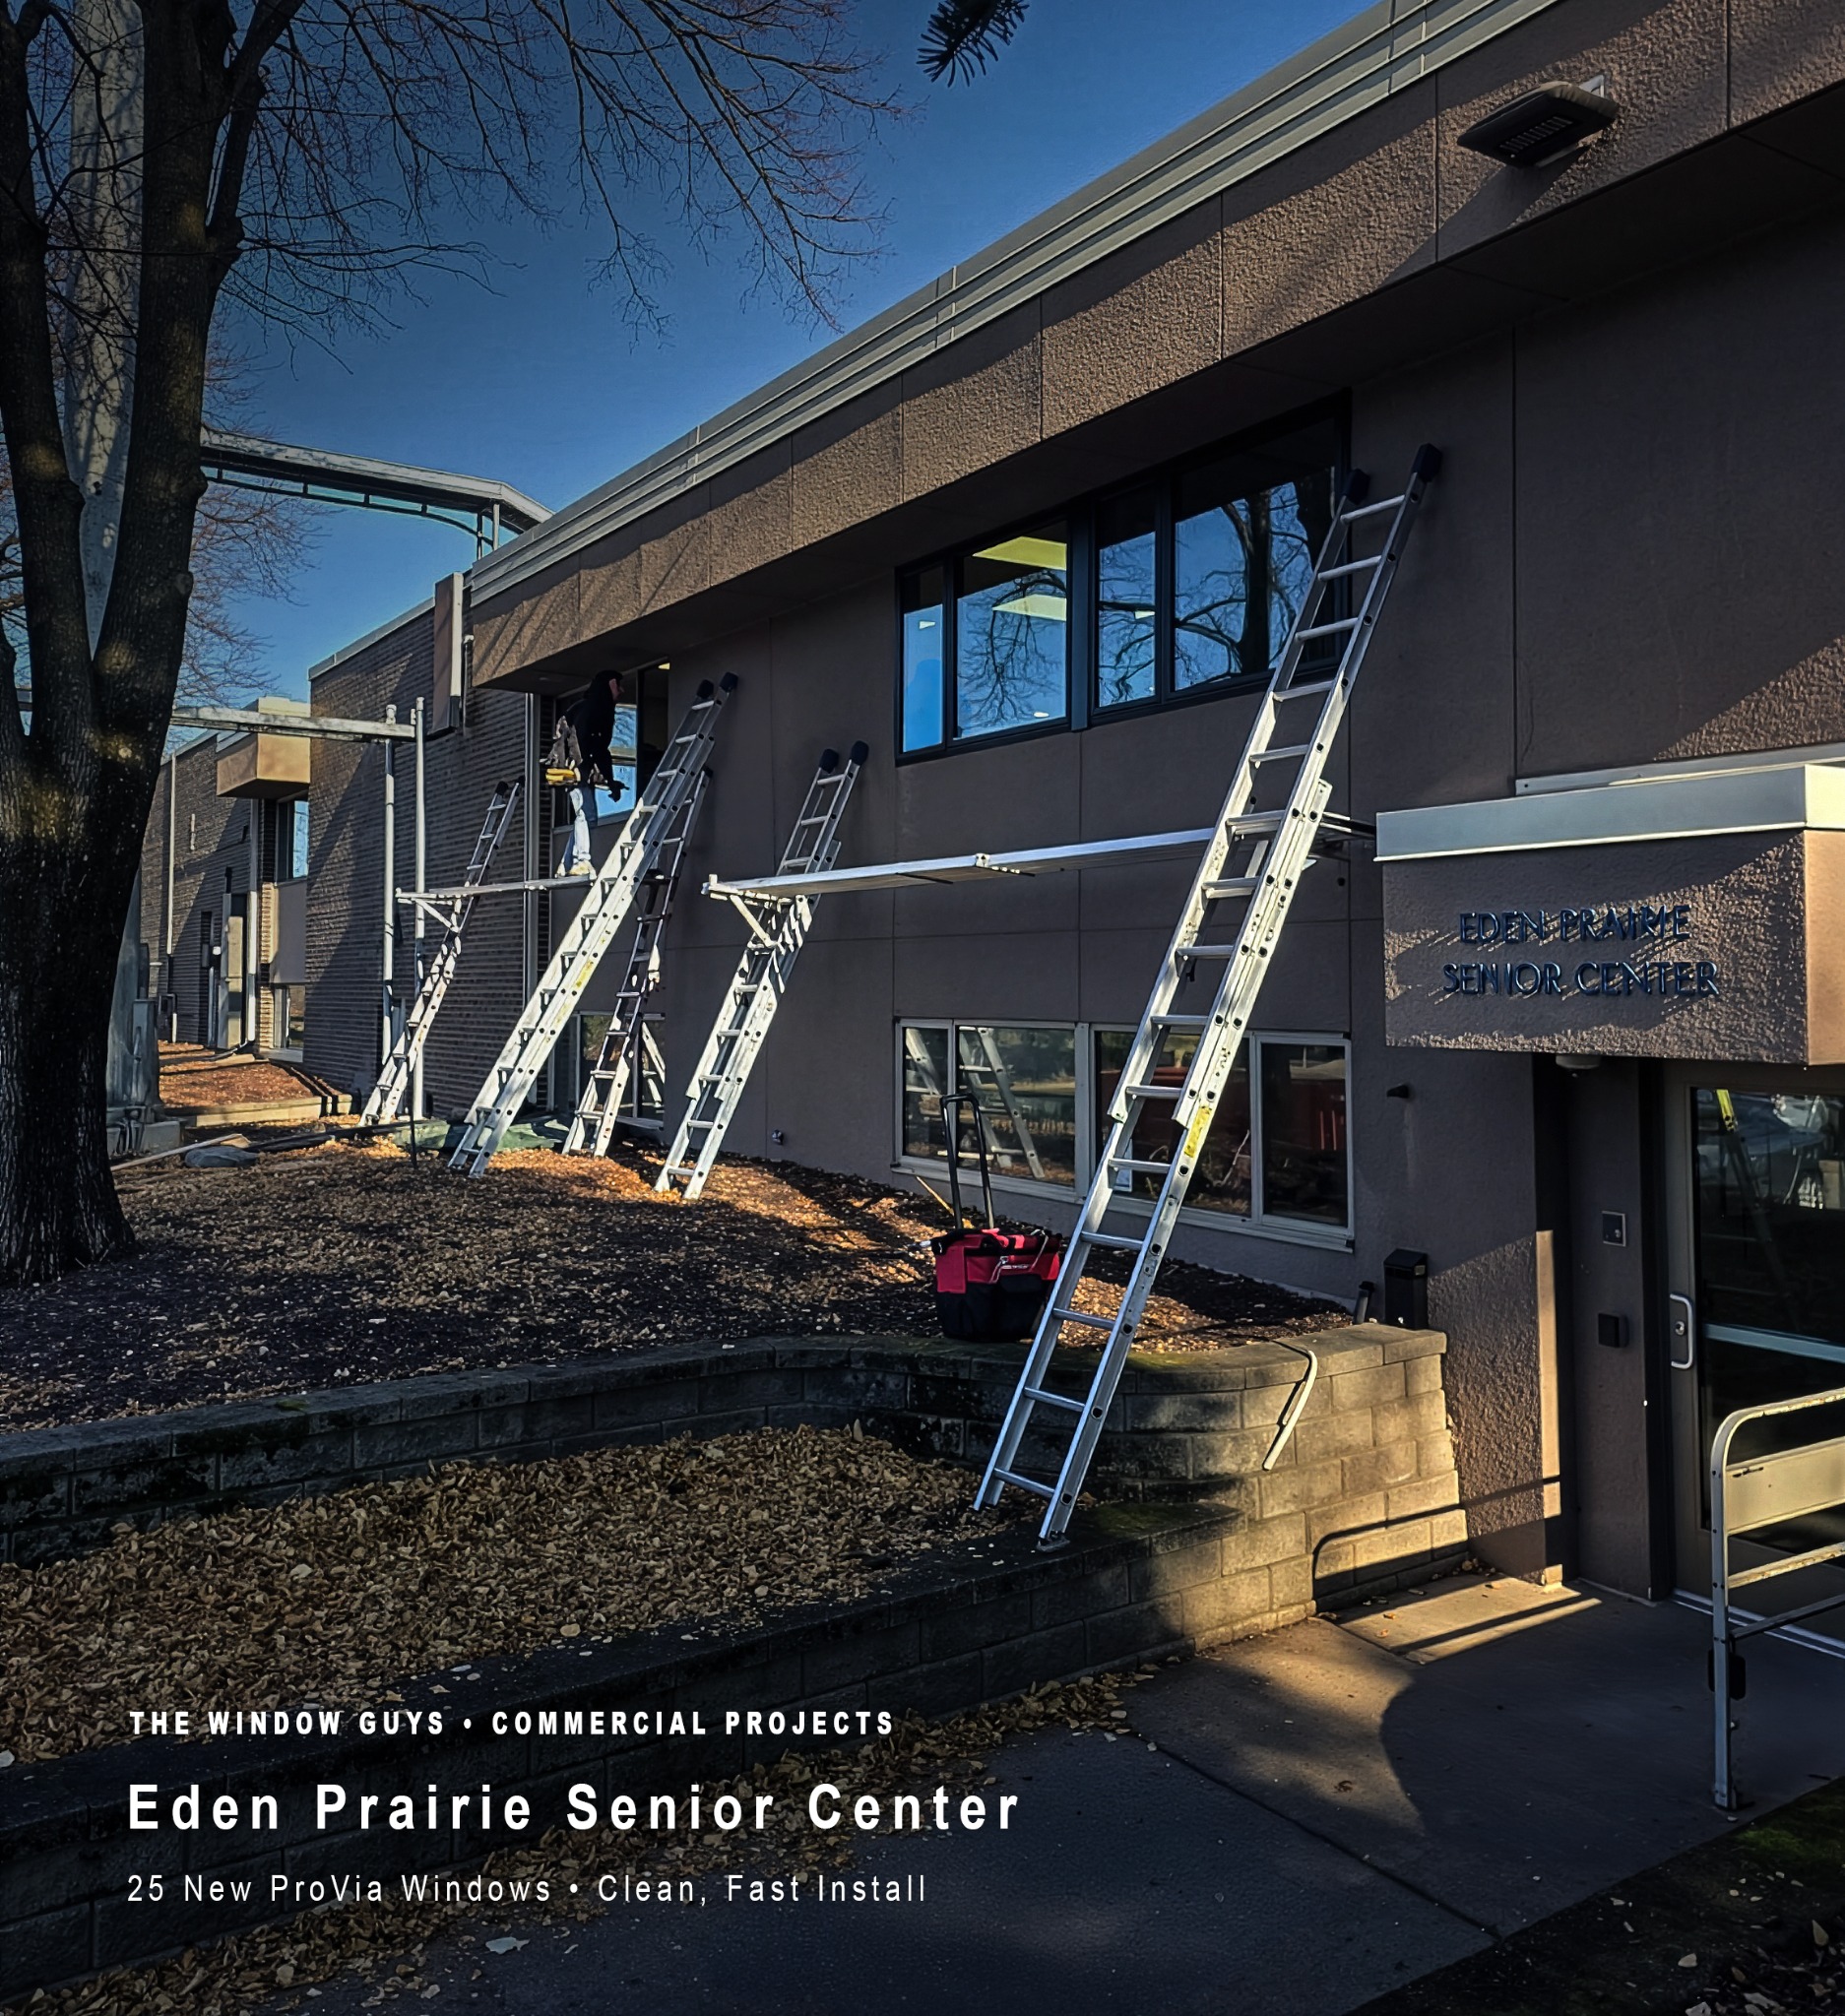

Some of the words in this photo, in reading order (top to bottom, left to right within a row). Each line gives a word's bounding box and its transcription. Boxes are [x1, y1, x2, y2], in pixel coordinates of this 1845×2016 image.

[1459, 910, 1546, 944] EDEN
[1442, 961, 1562, 996] SENIOR
[1575, 960, 1720, 996] CENTER
